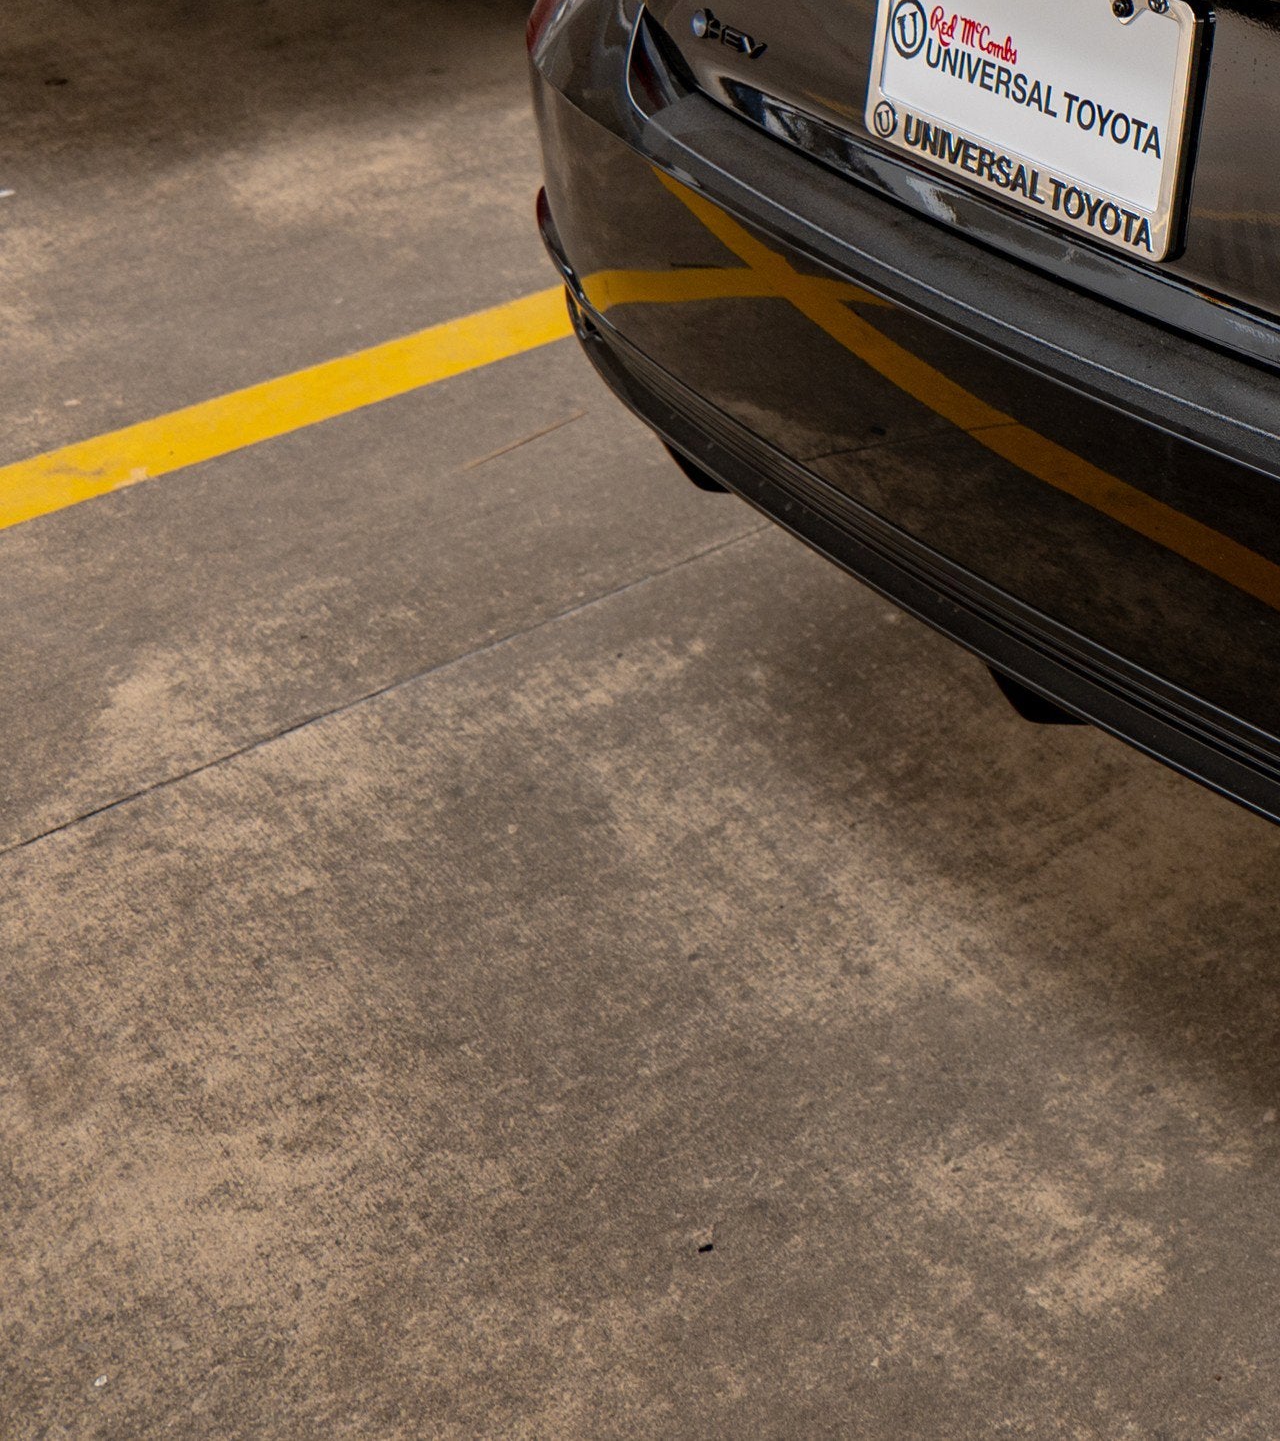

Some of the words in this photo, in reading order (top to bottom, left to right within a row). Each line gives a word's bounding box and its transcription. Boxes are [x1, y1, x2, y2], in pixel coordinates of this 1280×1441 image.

[929, 5, 959, 48] Red
[960, 16, 1018, 65] McCombs
[925, 37, 1058, 119] UNIVERSAL
[1063, 90, 1162, 160] TOYOTA
[903, 113, 1046, 205] UNIVERSAL
[1049, 176, 1155, 254] TOYOTA
